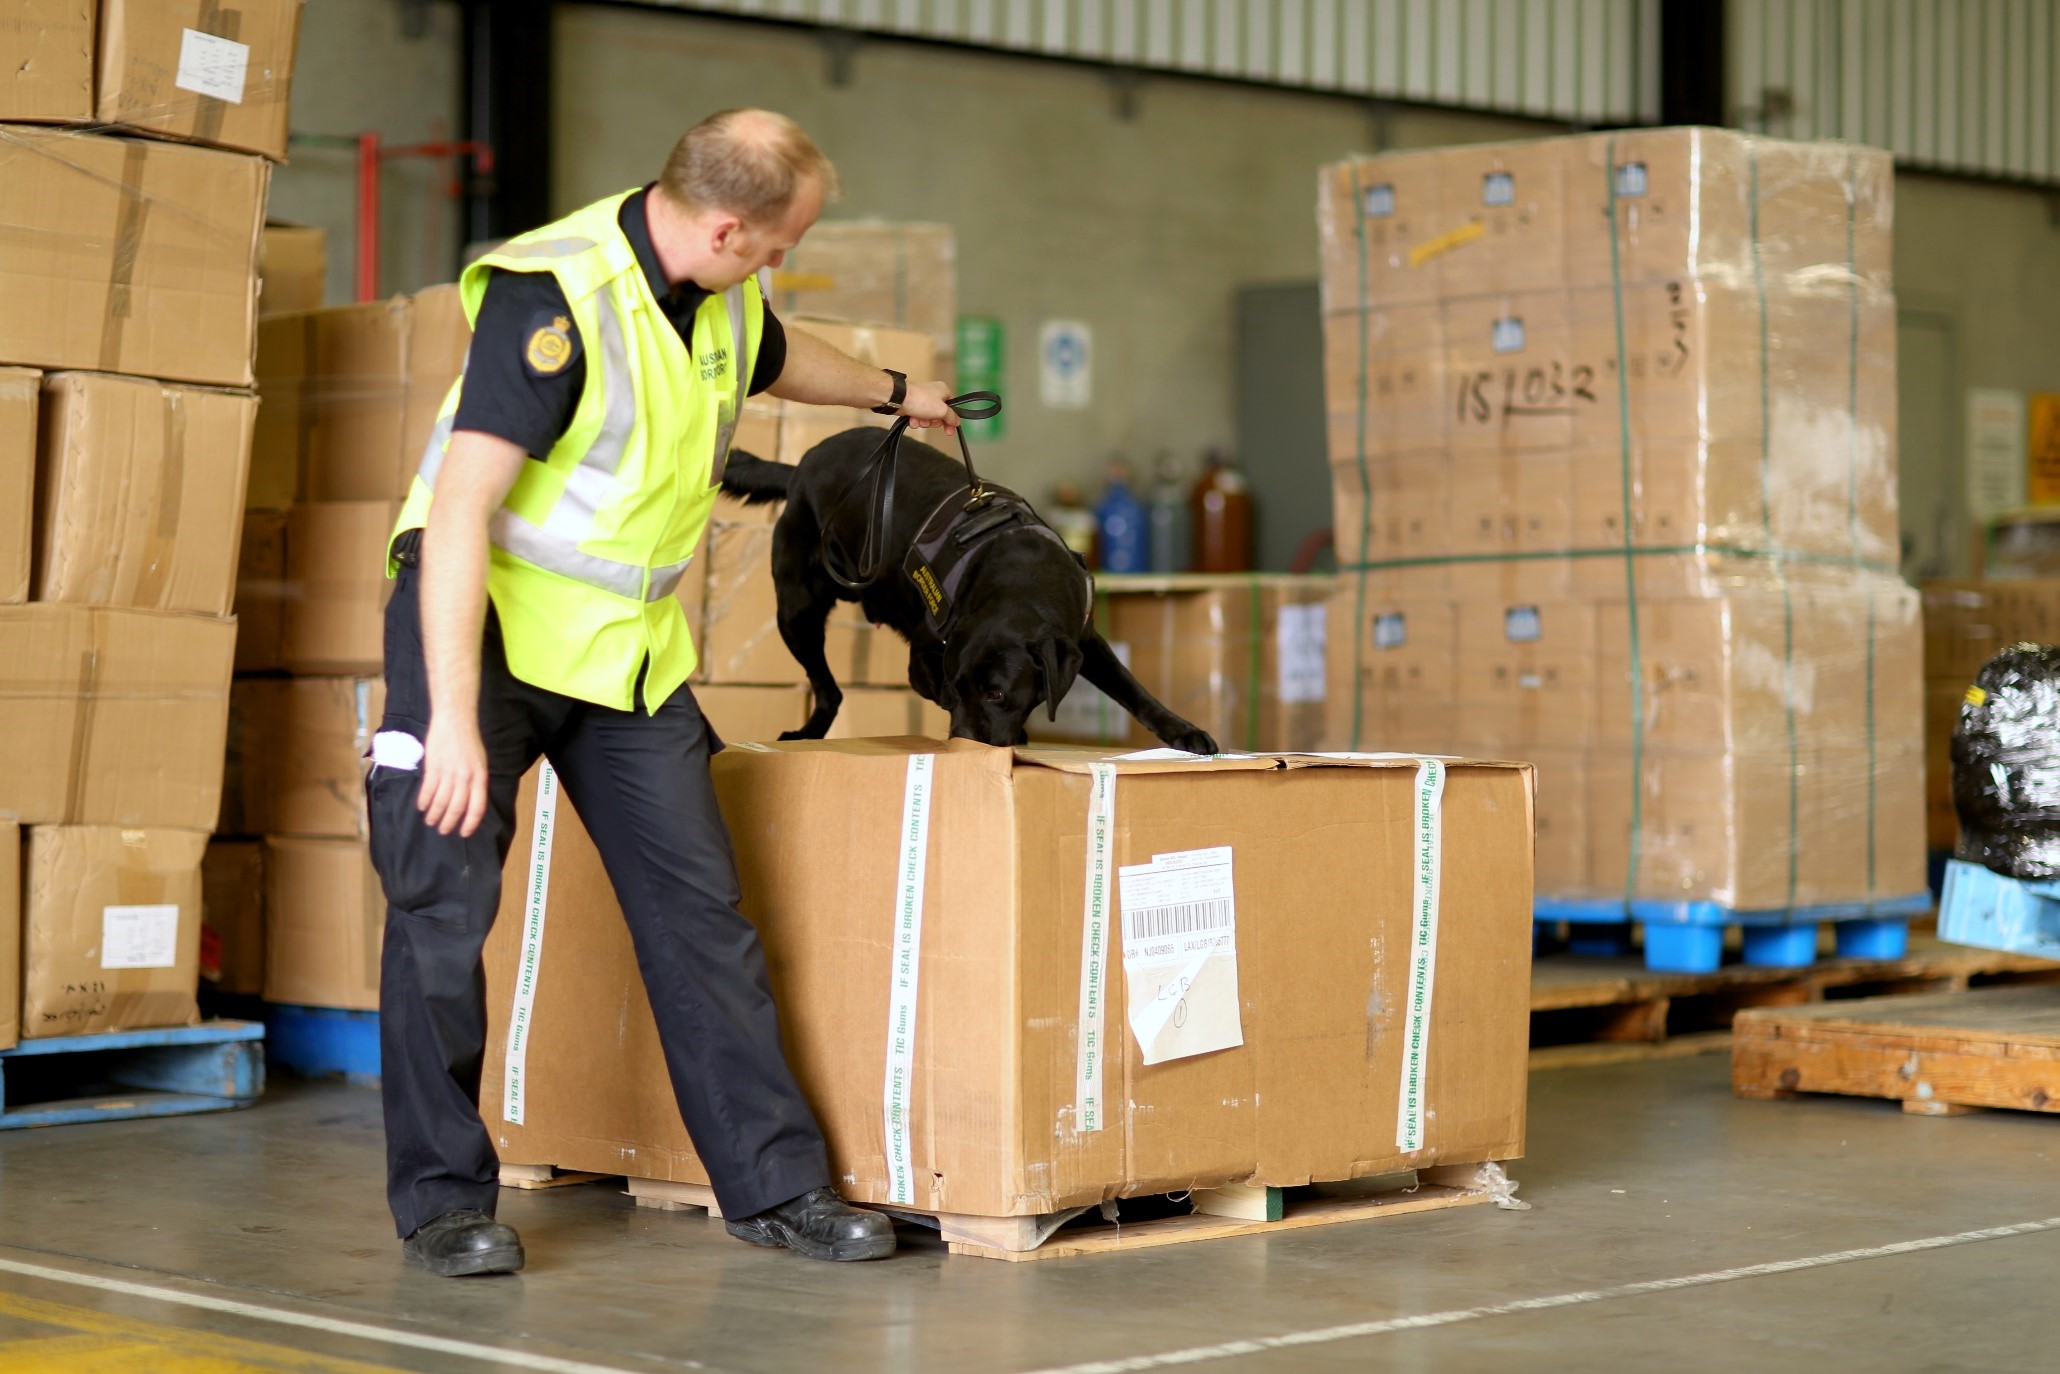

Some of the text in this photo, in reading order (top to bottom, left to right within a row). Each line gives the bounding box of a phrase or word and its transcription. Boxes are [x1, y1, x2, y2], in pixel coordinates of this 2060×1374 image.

[544, 767, 553, 795] Gums
[542, 810, 549, 821] IF
[909, 784, 923, 842] CONTENTS
[1096, 815, 1105, 826] IF
[1421, 788, 1433, 830] BROKEN
[538, 823, 548, 848] SEAL
[1096, 828, 1105, 854] SEAL
[1422, 832, 1431, 843] IS
[537, 851, 545, 861] IS
[906, 845, 917, 881] CHECK
[1095, 859, 1103, 870] IS
[1421, 845, 1431, 872] SEAL
[533, 864, 544, 905] BROKEN
[1421, 873, 1430, 885] IF
[903, 884, 915, 929] BROKEN
[1091, 873, 1103, 918] BROKEN
[529, 907, 540, 941] CHECK
[1419, 899, 1429, 928] Gums
[902, 932, 911, 944] IS
[1089, 921, 1101, 957] CHECK
[1418, 930, 1428, 947] TIC
[522, 943, 536, 996] CONTENTS
[900, 947, 911, 975] SEAL
[899, 977, 909, 988] IF
[1088, 960, 1099, 1019] CONTENTS
[1414, 955, 1426, 1012] CONTENTS
[517, 1006, 526, 1022] TIC
[897, 1004, 907, 1035] Gums
[513, 1024, 523, 1052] Gums
[1087, 1030, 1096, 1048] TIC
[1411, 1015, 1422, 1050] CHECK
[895, 1037, 905, 1056] TIC
[512, 1065, 519, 1075] IF
[1085, 1050, 1095, 1081] Gums
[1408, 1052, 1419, 1095] BROKEN
[510, 1077, 519, 1102] SEAL
[1408, 1097, 1417, 1108] IS
[510, 1104, 518, 1116] IS
[1085, 1097, 1094, 1109] IF
[1408, 1112, 1417, 1137] SEAL
[893, 1128, 904, 1162] CHECK
[1407, 1139, 1416, 1149] IF
